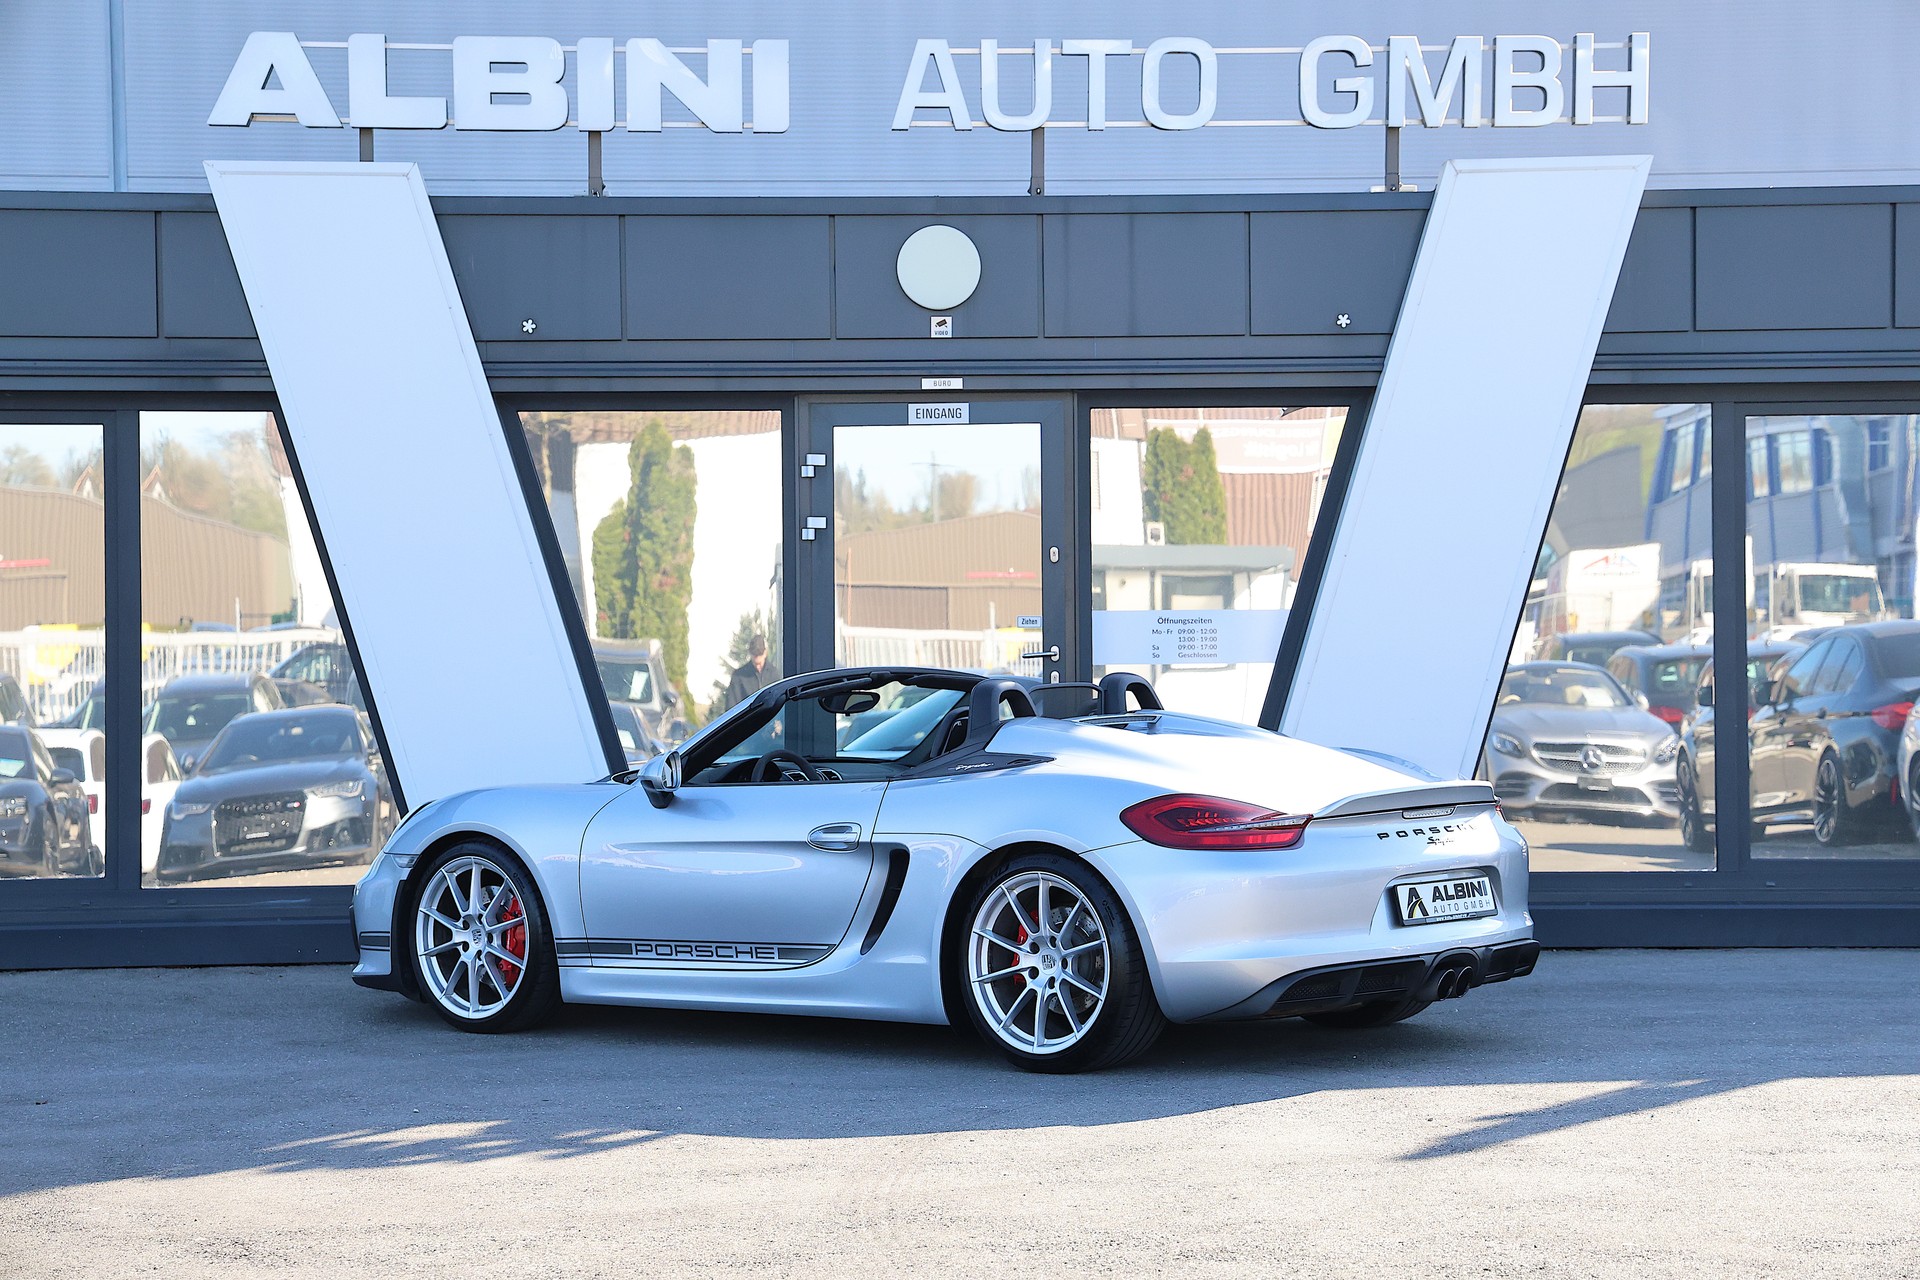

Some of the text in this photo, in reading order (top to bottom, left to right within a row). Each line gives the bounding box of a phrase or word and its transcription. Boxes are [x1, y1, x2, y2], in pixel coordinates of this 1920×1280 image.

[207, 31, 1650, 133] ALBINI AUTO GMBH
[915, 407, 962, 419] EINGANG
[1157, 616, 1213, 625] Öffnungszeiten
[1432, 880, 1488, 902] ALBINI
[1433, 899, 1491, 914] AUTO GMBH
[635, 943, 775, 959] PORSCHE
